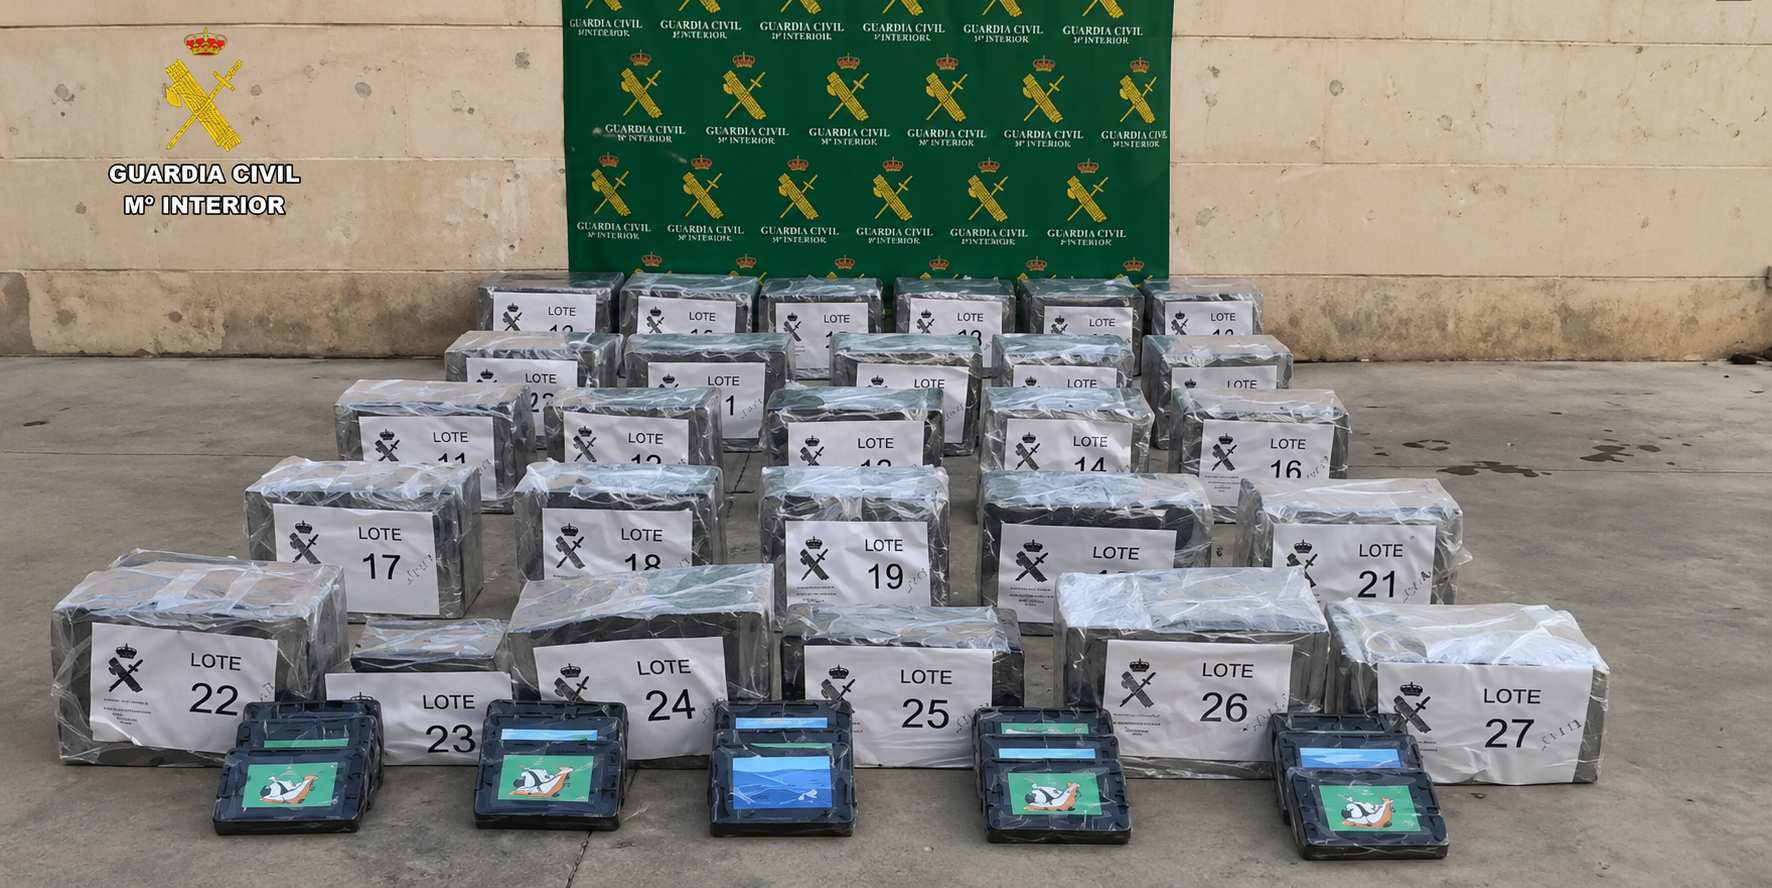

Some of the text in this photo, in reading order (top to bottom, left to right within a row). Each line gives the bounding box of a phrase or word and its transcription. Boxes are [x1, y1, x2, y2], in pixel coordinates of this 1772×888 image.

[569, 19, 643, 29] GUARDIA CIVIL
[660, 20, 742, 31] GUARDIA CIVIL
[760, 21, 844, 32] GUARDIA CIVIL
[863, 23, 945, 33] GUARDIA CIVIL
[963, 24, 1043, 34] GUARDIA CIVIL
[1063, 25, 1143, 36] GUARDIA CIVIL
[605, 124, 686, 135] GUARDIA CIVIL
[706, 126, 789, 136] GUARDIA CIVIL
[809, 128, 890, 137] GUARDIA CIVIL
[907, 129, 987, 138] GUARDIA CIVIL
[1004, 130, 1084, 140] GUARDIA CIVIL
[1101, 130, 1147, 140] GUARDIA
[628, 134, 673, 143] INTERIOR
[729, 137, 775, 145] INTERIOR
[834, 138, 878, 146] INTERIOR
[931, 139, 974, 147] INTERIOR
[1027, 140, 1071, 148] INTERIOR
[577, 222, 651, 232] GUARDIA CIVIL
[667, 224, 744, 234] GUARDIA CIVIL
[761, 226, 839, 236] GUARDIA CIVIL
[856, 227, 933, 237] GUARDIA CIVIL
[950, 228, 1028, 237] GUARDIA CIVIL
[1048, 229, 1126, 238] GUARDIA CIVIL
[548, 306, 576, 316] LOTE
[1210, 312, 1236, 321] LOTE
[689, 312, 716, 322] LOTE
[824, 314, 850, 324] LOTE
[957, 312, 984, 322] LOTE
[1089, 318, 1115, 328] LOTE
[525, 373, 557, 384] LOTE
[708, 376, 740, 386] LOTE
[914, 378, 945, 389] LOTE
[1067, 379, 1097, 389] LOTE
[1227, 379, 1257, 389] LOTE
[433, 432, 469, 443] LOTE
[628, 432, 664, 445] LOTE
[1073, 435, 1108, 448] LOTE
[858, 438, 894, 449] LOTE
[1270, 438, 1306, 450] LOTE
[1074, 456, 1107, 472] 14
[1270, 459, 1302, 479] 16
[358, 526, 402, 542] LOTE
[621, 528, 663, 542] LOTE
[864, 539, 904, 552] LOTE
[1358, 543, 1404, 558] LOTE
[1093, 546, 1140, 561] LOTE
[362, 552, 401, 580] 17
[624, 553, 661, 572] 18
[868, 563, 904, 590] 19
[1357, 570, 1396, 598] 21
[190, 652, 241, 671] LOTE
[637, 659, 692, 676] LOTE
[1202, 662, 1254, 679] LOTE
[901, 669, 953, 685] LOTE
[189, 682, 240, 717] 22
[422, 694, 476, 710] LOTE
[1483, 688, 1542, 705] LOTE
[645, 688, 696, 722] 24
[1200, 692, 1248, 723] 26
[901, 698, 950, 729] 25
[425, 724, 476, 753] 23
[1485, 718, 1535, 749] 27
